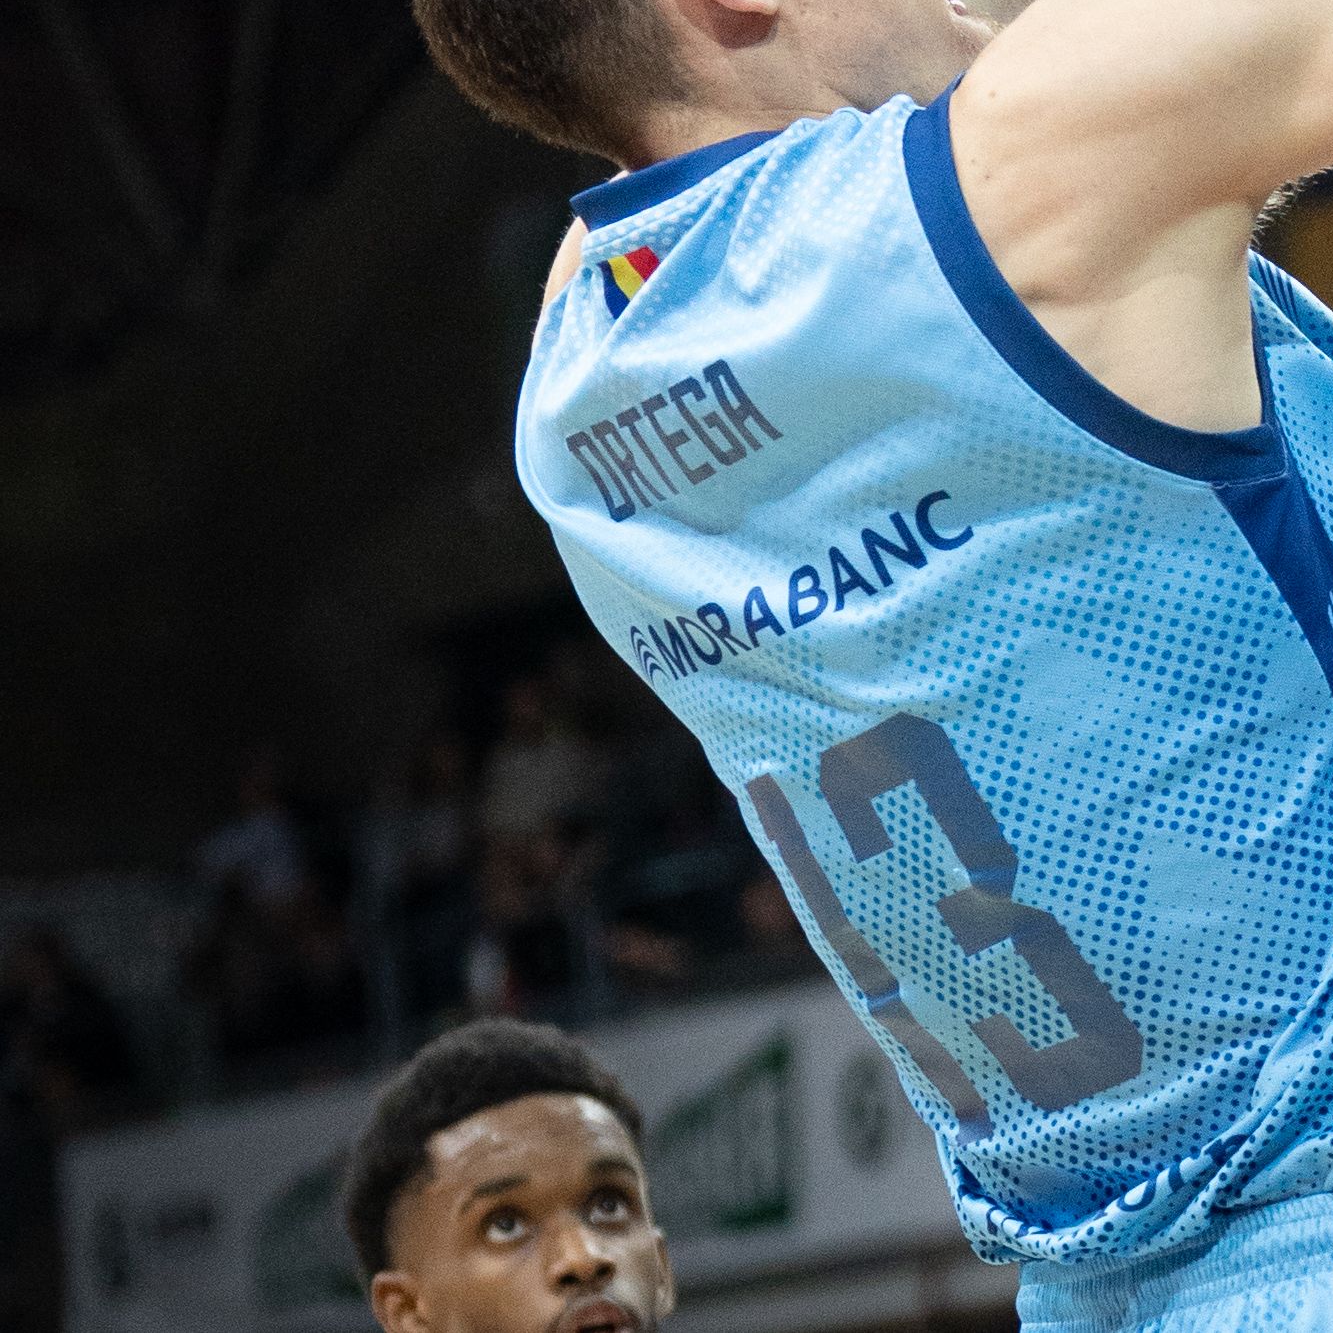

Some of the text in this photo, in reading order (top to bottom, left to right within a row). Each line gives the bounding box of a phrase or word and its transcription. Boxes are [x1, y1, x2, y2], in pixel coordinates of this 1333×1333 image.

[566, 359, 784, 523] ORTEGA
[648, 489, 974, 681] MORABANC
[745, 711, 1144, 1146] 13
